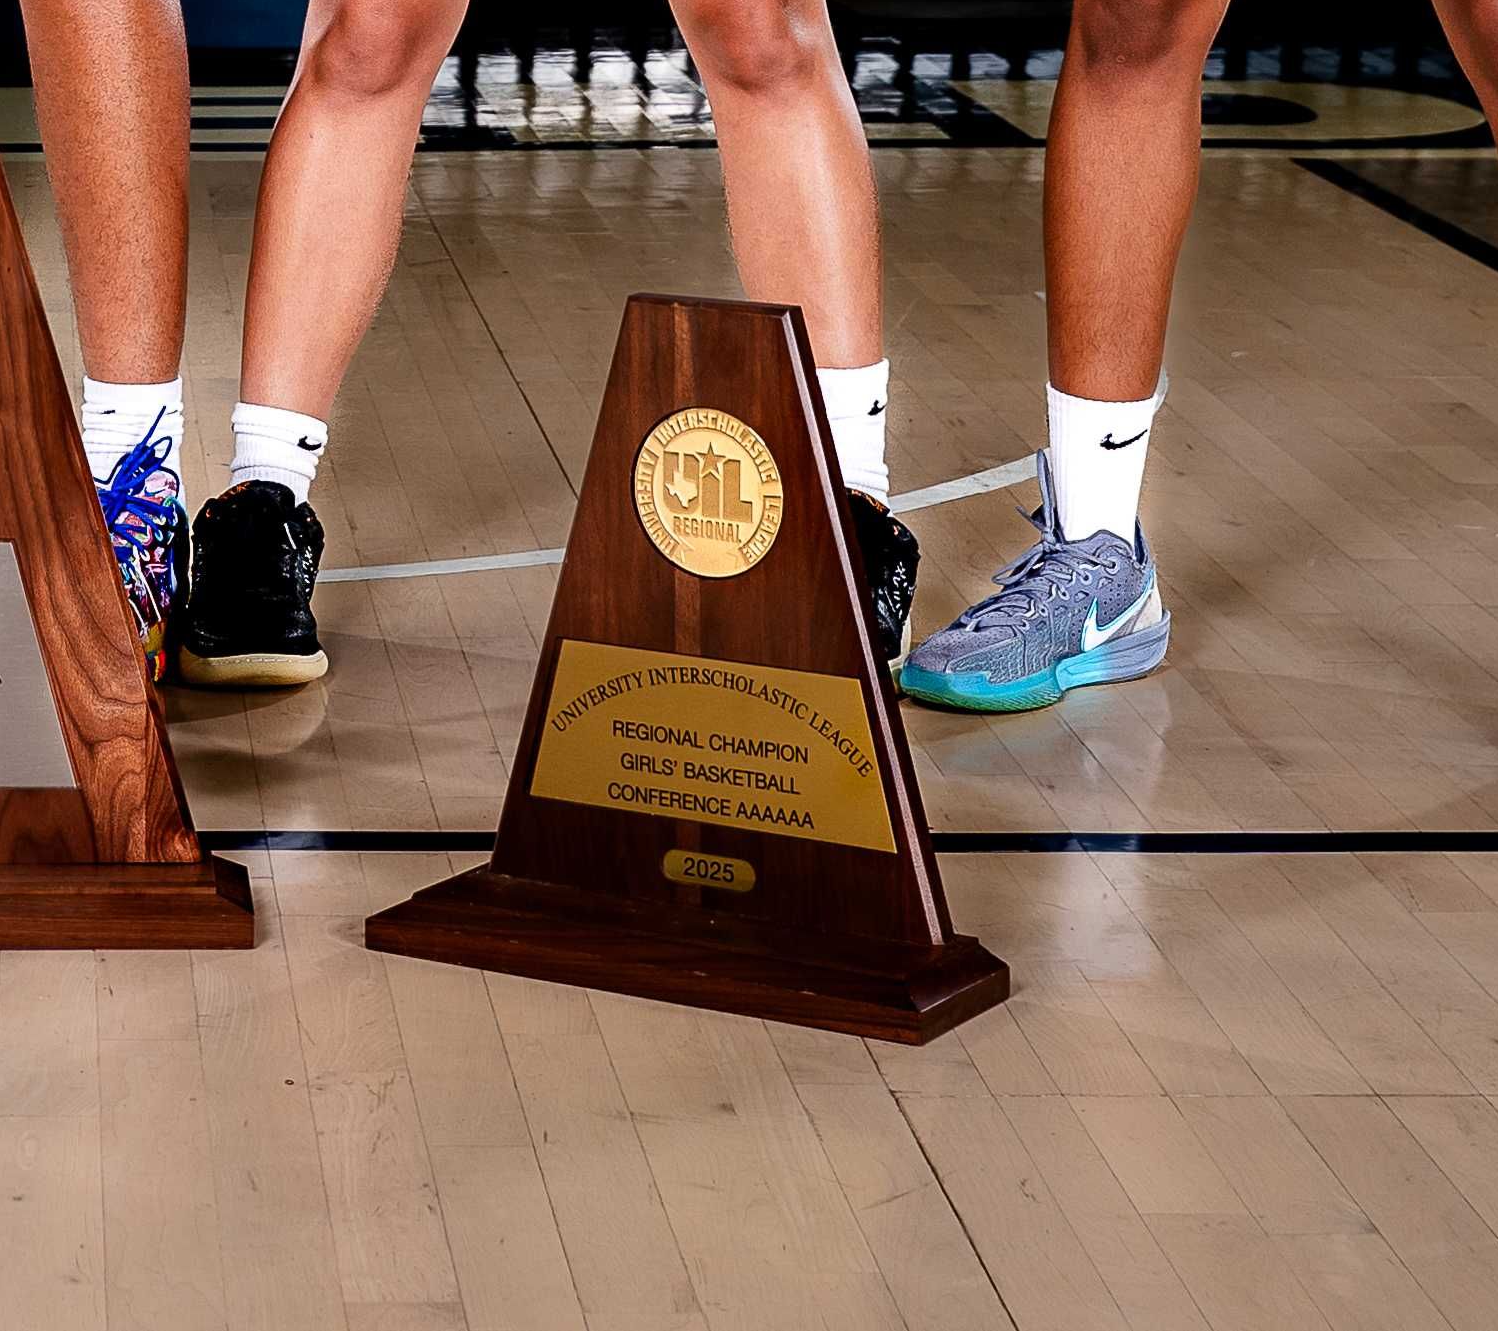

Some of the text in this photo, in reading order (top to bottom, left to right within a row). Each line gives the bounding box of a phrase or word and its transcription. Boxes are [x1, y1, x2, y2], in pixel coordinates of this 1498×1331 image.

[673, 516, 742, 544] REGIONAL
[552, 666, 873, 778] UNIVERSITY INTERSCHOLASTIC LEAGUE
[613, 720, 808, 764] REGIONAL CHAMPION
[684, 764, 800, 795] BASKETBALL
[608, 782, 814, 829] CONFERENCE AAAAAA
[683, 856, 734, 883] 2025
